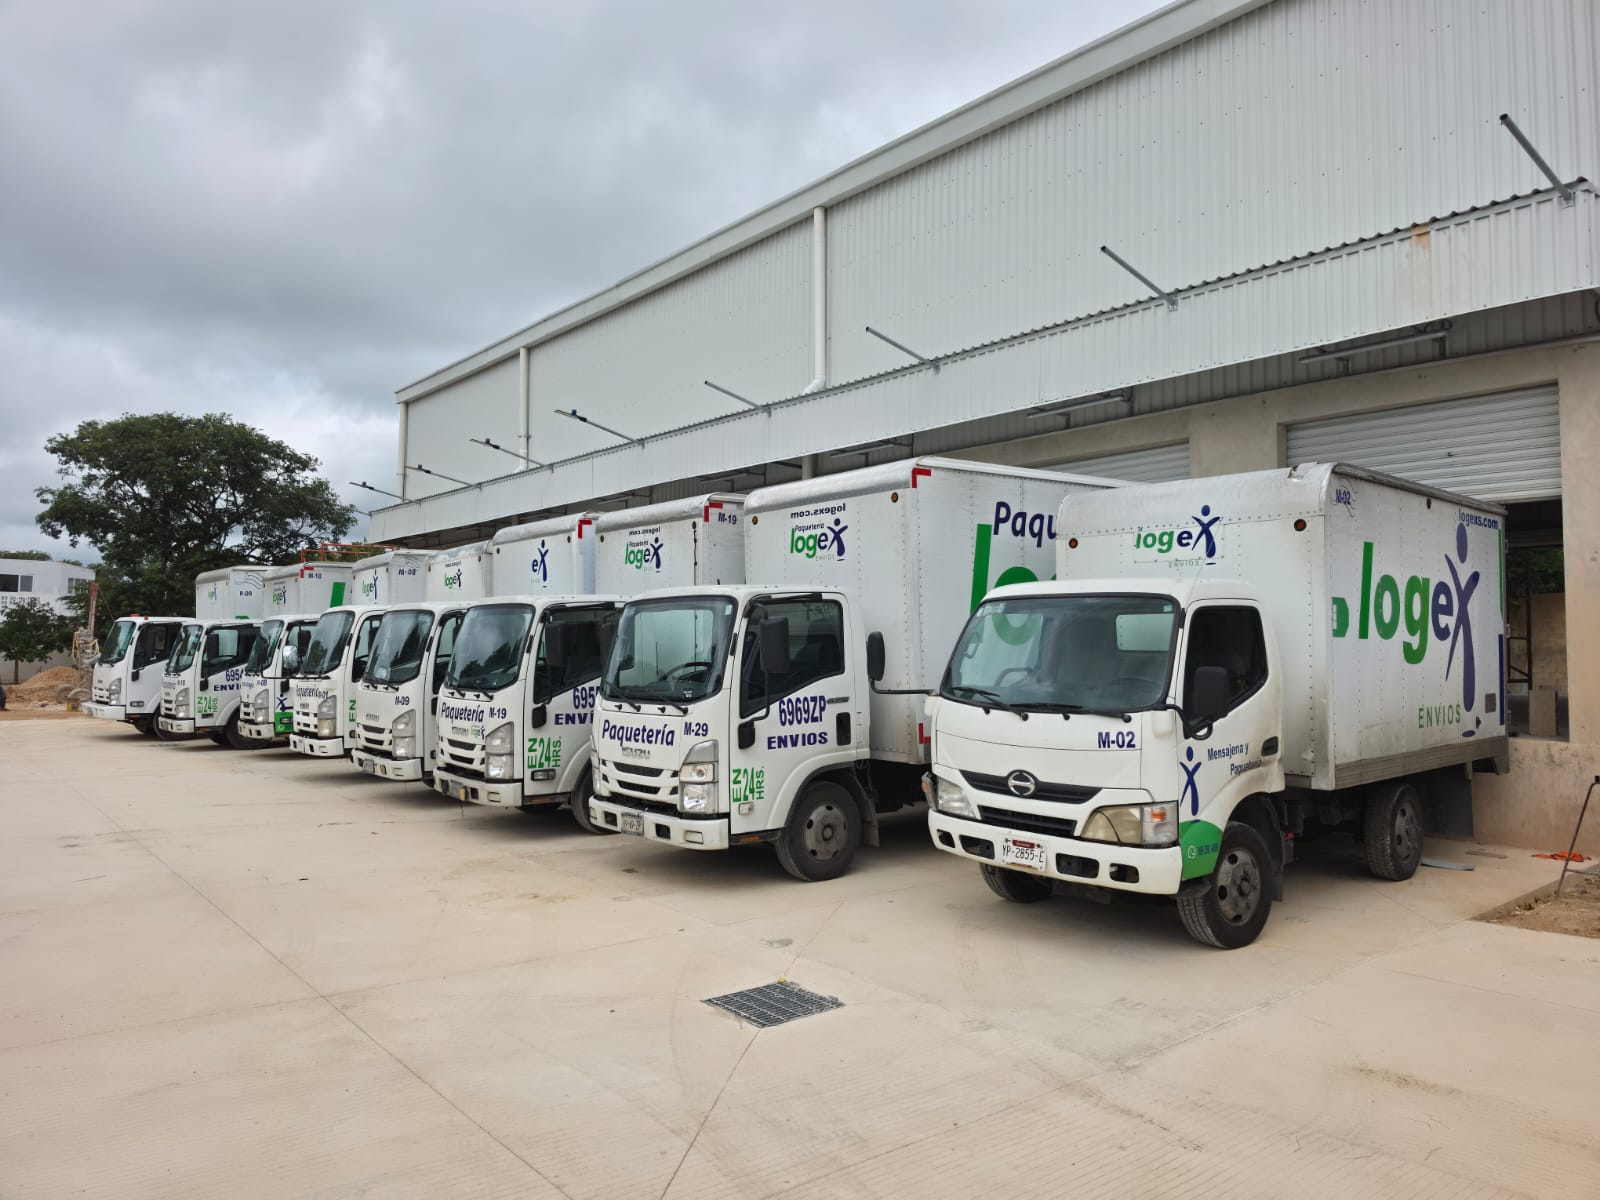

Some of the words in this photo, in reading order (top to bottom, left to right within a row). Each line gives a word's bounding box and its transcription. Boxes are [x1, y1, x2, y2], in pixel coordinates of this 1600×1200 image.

[718, 512, 737, 525] M-19
[790, 517, 848, 559] logex
[441, 702, 484, 724] Paquetería
[778, 695, 826, 727] 6969ZP
[1418, 703, 1461, 729] ENVIOS
[602, 719, 675, 747] Paquetería
[683, 721, 709, 737] M-29
[767, 731, 829, 750] ENVIOS
[1097, 731, 1136, 749] M-02
[528, 737, 538, 769] EN
[538, 736, 552, 769] 24
[732, 768, 742, 803] EN
[742, 767, 755, 801] 24
[756, 765, 765, 800] HRS.
